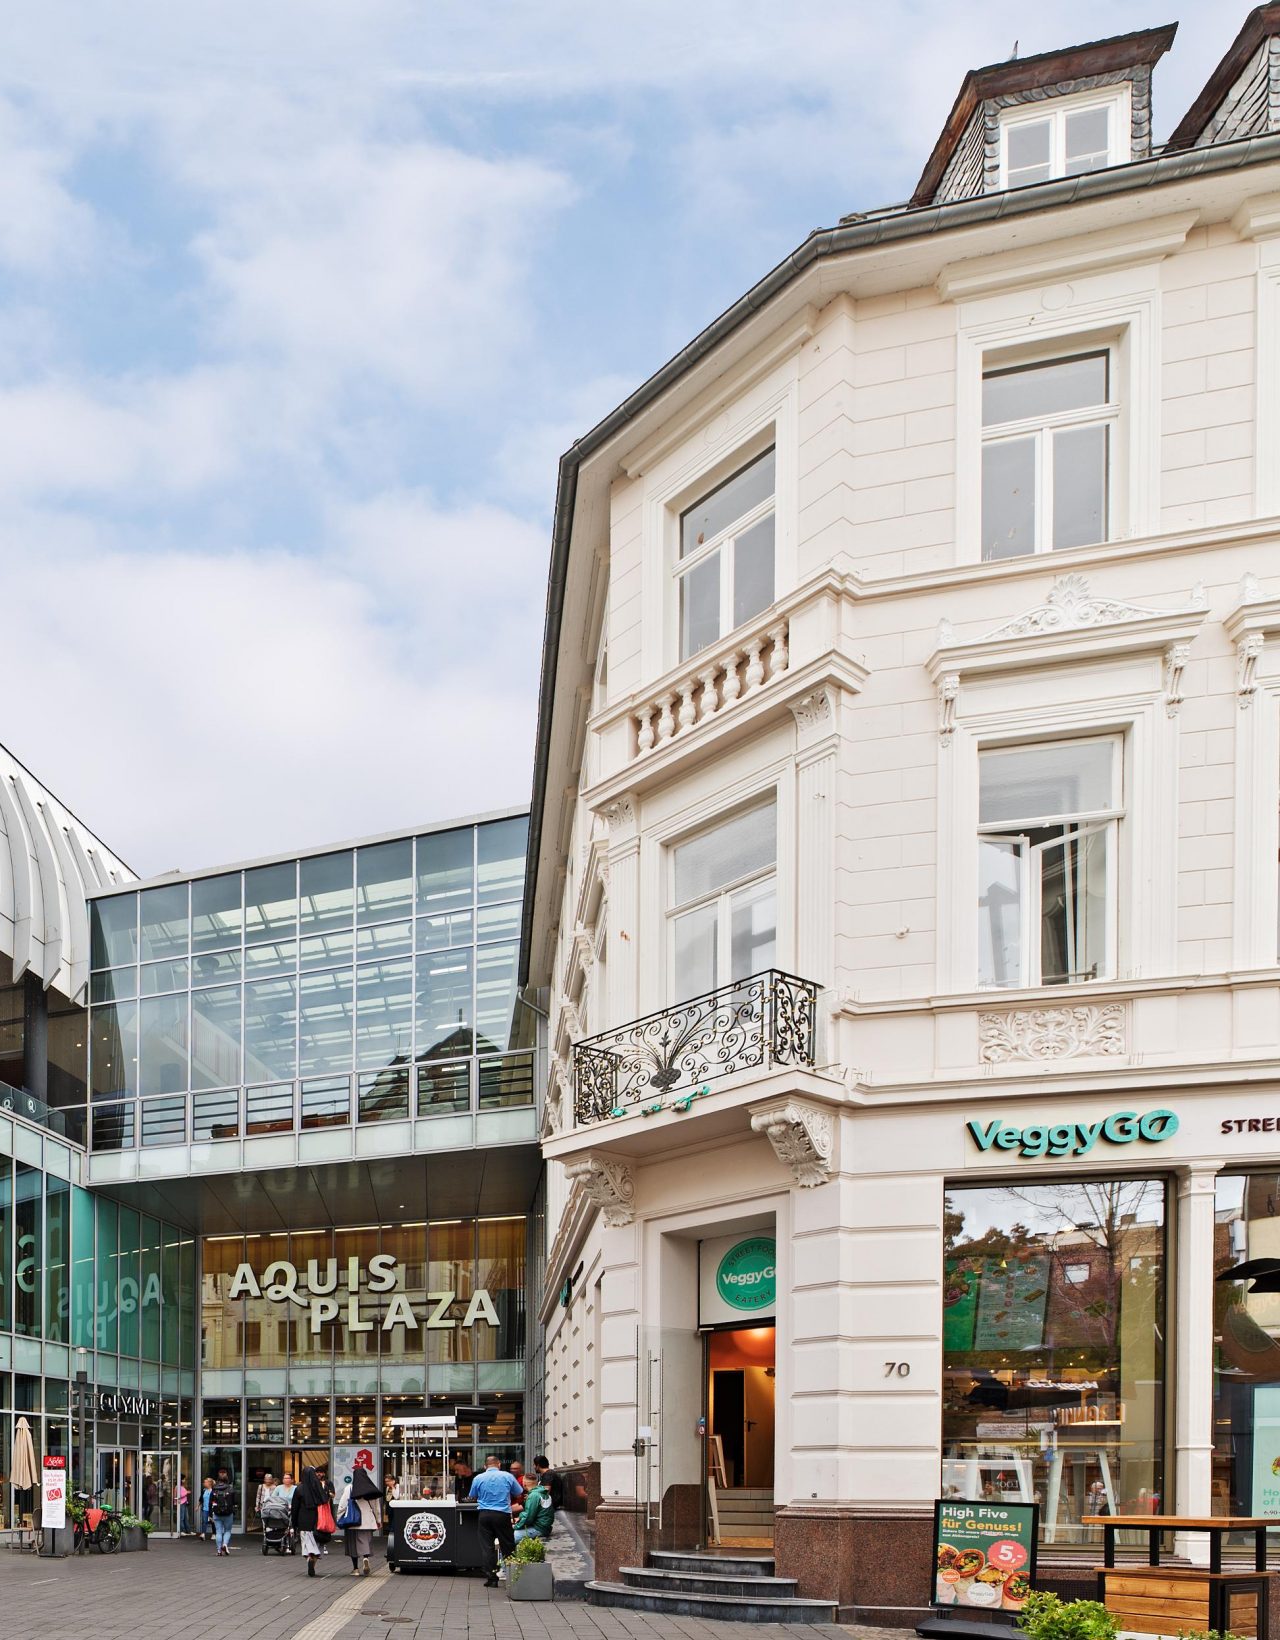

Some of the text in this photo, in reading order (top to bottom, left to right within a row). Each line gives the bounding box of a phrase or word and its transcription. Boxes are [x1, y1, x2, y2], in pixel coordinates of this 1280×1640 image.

[967, 1109, 1180, 1157] VeggyGO
[1221, 1117, 1280, 1134] STRE
[229, 1254, 397, 1307] AQUIS
[722, 1266, 776, 1285] VeggyG
[310, 1289, 501, 1334] PLAZA
[884, 1362, 910, 1378] 70
[1263, 1497, 1275, 1506] of
[942, 1507, 1008, 1519] High Five
[942, 1518, 1023, 1532] für Genuss!
